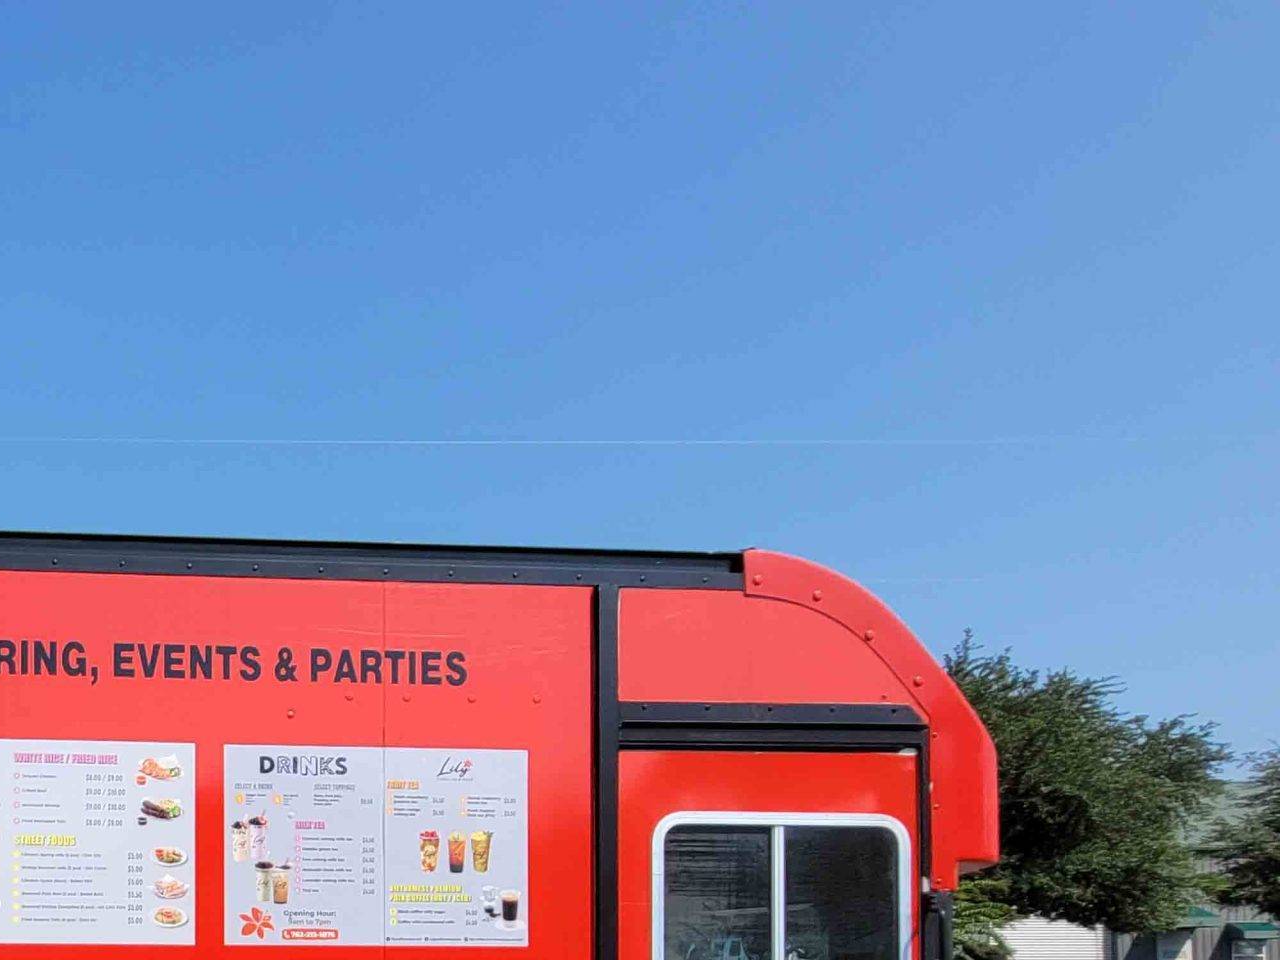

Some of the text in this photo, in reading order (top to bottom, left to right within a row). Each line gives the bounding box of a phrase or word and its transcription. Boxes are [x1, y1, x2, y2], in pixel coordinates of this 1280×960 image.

[113, 644, 261, 681] EVENTS
[274, 647, 297, 682] &
[310, 649, 467, 686] PARTIES
[259, 755, 348, 776] DRINKS
[436, 756, 470, 778] Lily
[283, 909, 315, 918] Opening
